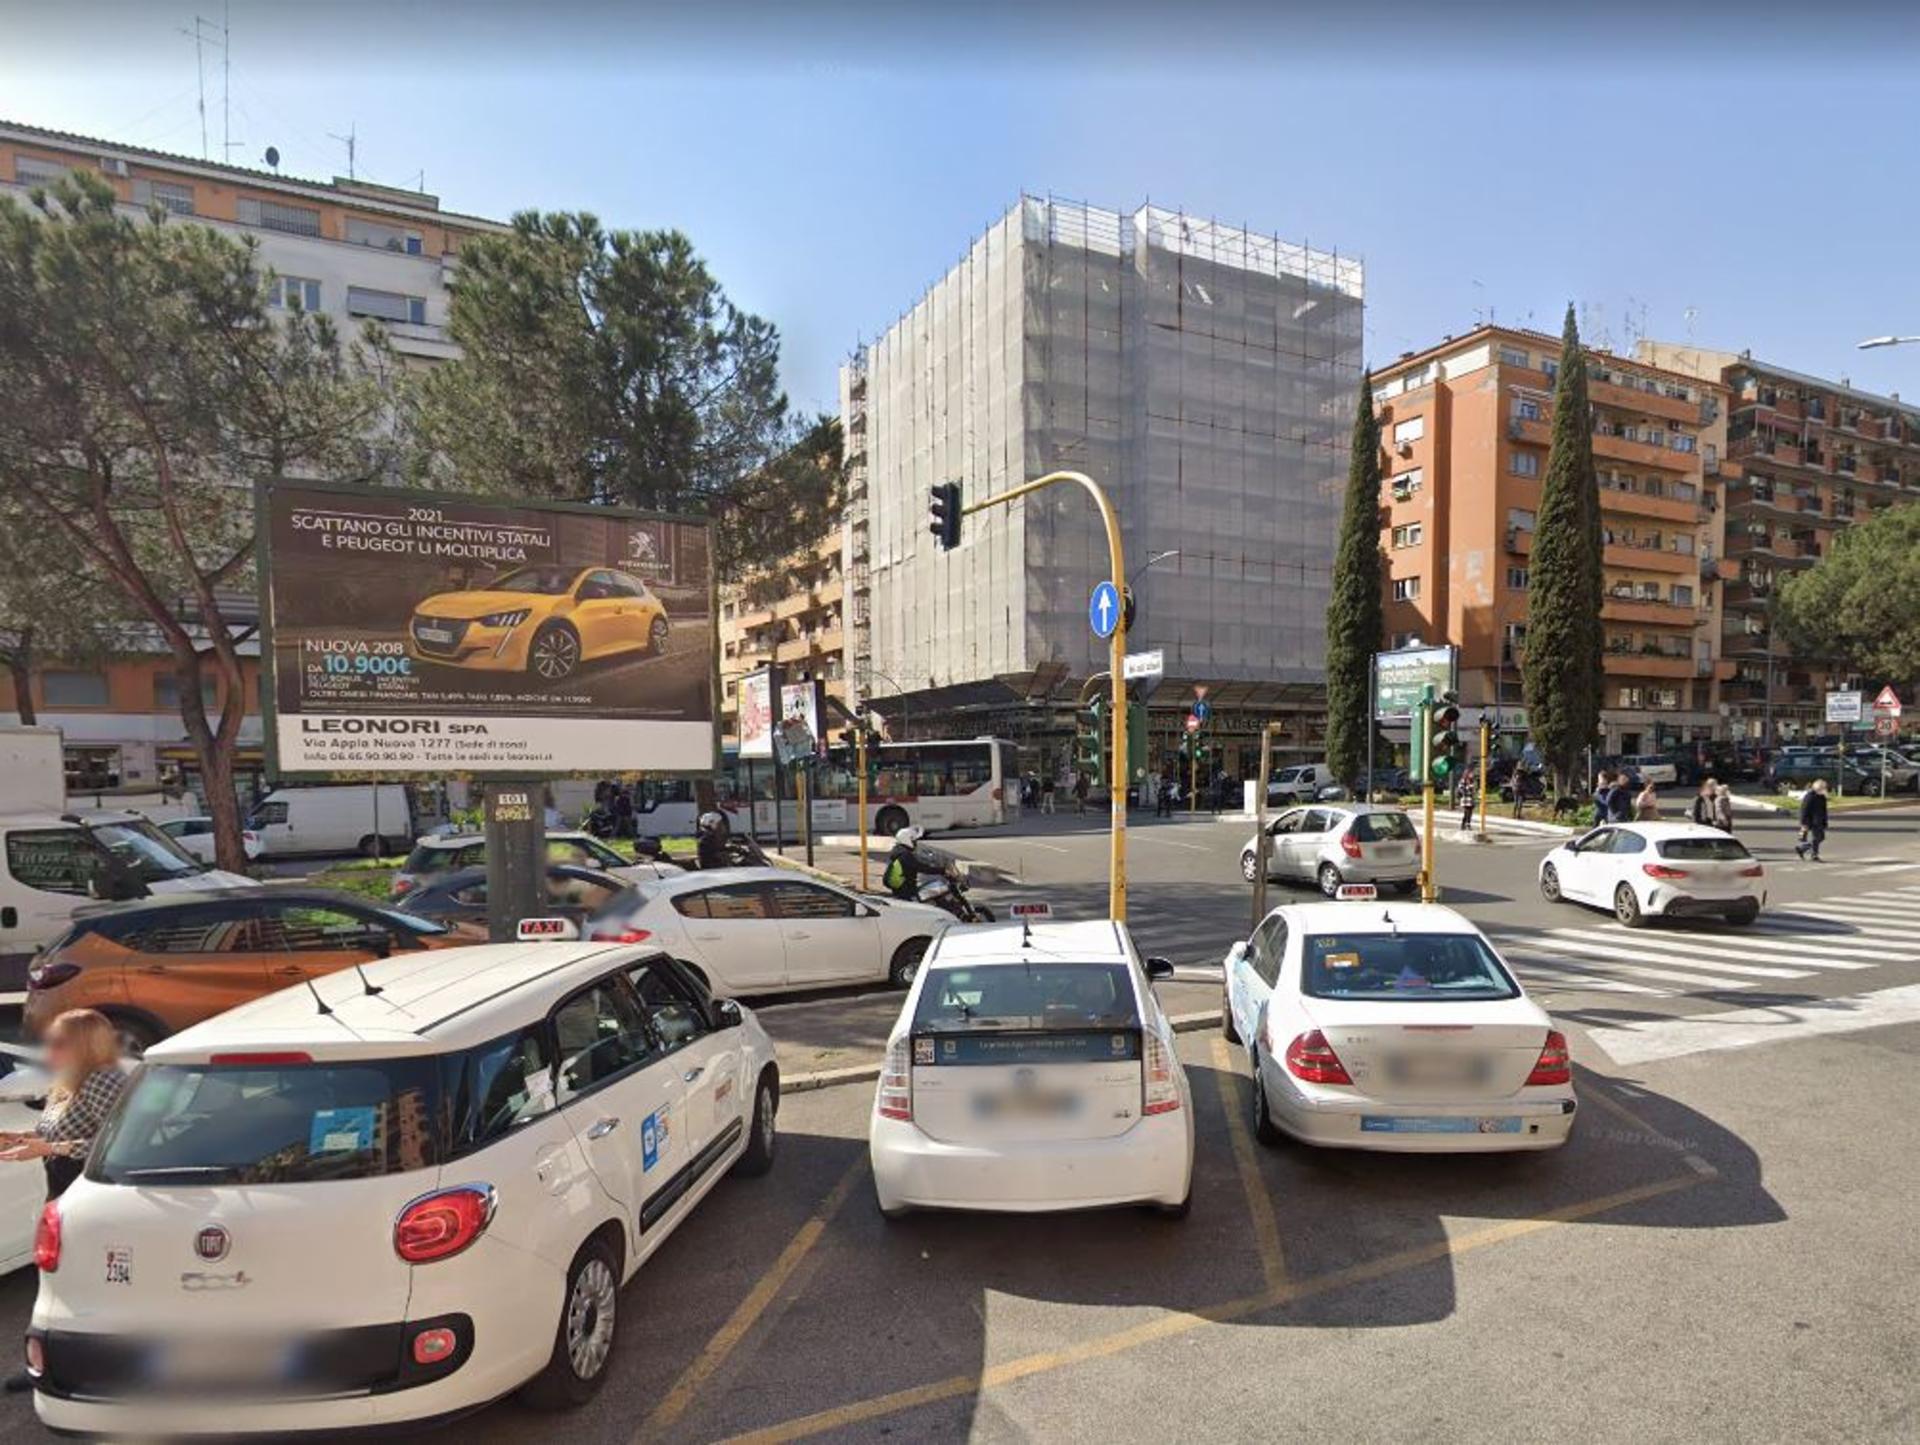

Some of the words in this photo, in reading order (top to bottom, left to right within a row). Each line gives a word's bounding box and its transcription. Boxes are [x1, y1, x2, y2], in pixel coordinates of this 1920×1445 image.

[408, 508, 442, 521] 2021
[291, 514, 381, 534] SCATTANO
[385, 521, 412, 537] GLI
[416, 525, 493, 543] INCENTIVI
[497, 531, 550, 547] STATALI
[322, 534, 332, 548] E
[336, 535, 414, 554] PEUGEOT
[435, 542, 527, 560] MOLTIPLICA
[306, 640, 369, 653] NUOVA
[373, 641, 403, 655] 208
[307, 663, 323, 673] DA
[323, 653, 412, 675] 10.900€
[302, 719, 440, 735] LEONORI
[447, 724, 488, 735] SPA
[303, 739, 326, 748] Via
[331, 739, 369, 749] Appia
[373, 739, 416, 748] Nuova
[421, 739, 451, 748] 1277
[522, 920, 563, 934] TAXI
